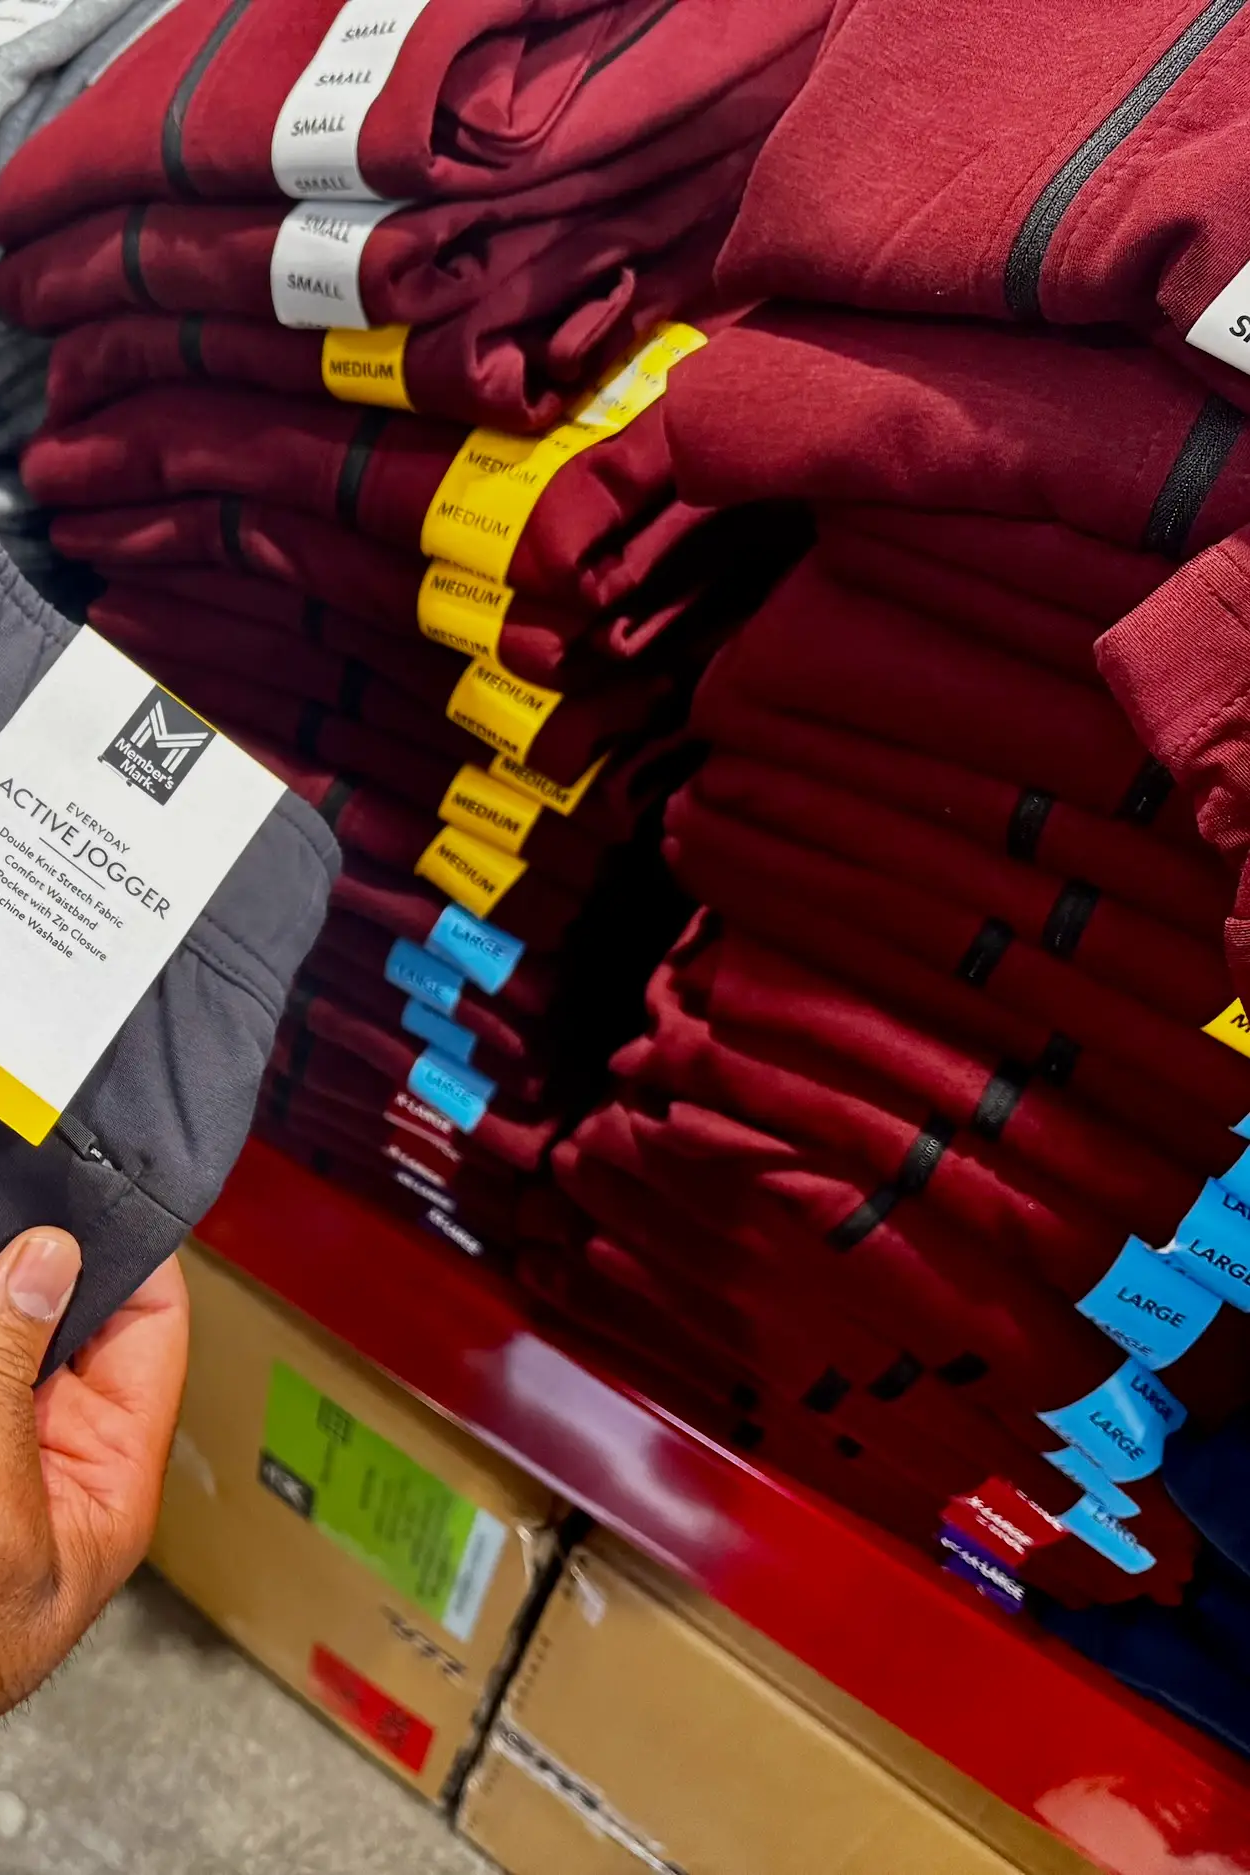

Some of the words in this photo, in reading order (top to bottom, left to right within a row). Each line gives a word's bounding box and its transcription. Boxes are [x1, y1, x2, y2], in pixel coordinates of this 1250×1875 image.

[342, 19, 397, 42] SMALL
[315, 69, 372, 86] SMALL
[291, 115, 345, 136] SMALL
[295, 176, 350, 193] SMALL
[286, 274, 345, 300] SMALL
[330, 361, 395, 380] MEDIUM
[465, 450, 538, 485] MEDIUM
[437, 500, 510, 540] MEDIUM
[429, 575, 503, 608] MEDIUM
[472, 666, 545, 712] MEDIUM
[453, 710, 519, 754] MEDIUM
[114, 737, 175, 791] Member's
[501, 755, 570, 804] MEDIUM
[65, 802, 131, 854] EVERYDAY
[452, 792, 521, 835] MEDIUM
[72, 839, 171, 920] JOGGER
[436, 843, 496, 895] MEDIUM
[4, 854, 46, 891] Comfort
[46, 885, 99, 931] Waistband
[35, 855, 58, 877] Knit
[56, 872, 94, 905] Stretch
[93, 900, 125, 929] Fabric
[27, 916, 74, 959] Washable
[29, 897, 52, 919] with
[51, 914, 69, 933] Zip
[70, 928, 107, 962] Closure
[451, 923, 504, 960] LARGE
[425, 1067, 474, 1108] LARGE
[1222, 1192, 1250, 1220] LA
[1116, 1286, 1188, 1329] LARGE
[1089, 1411, 1146, 1462] LARGE
